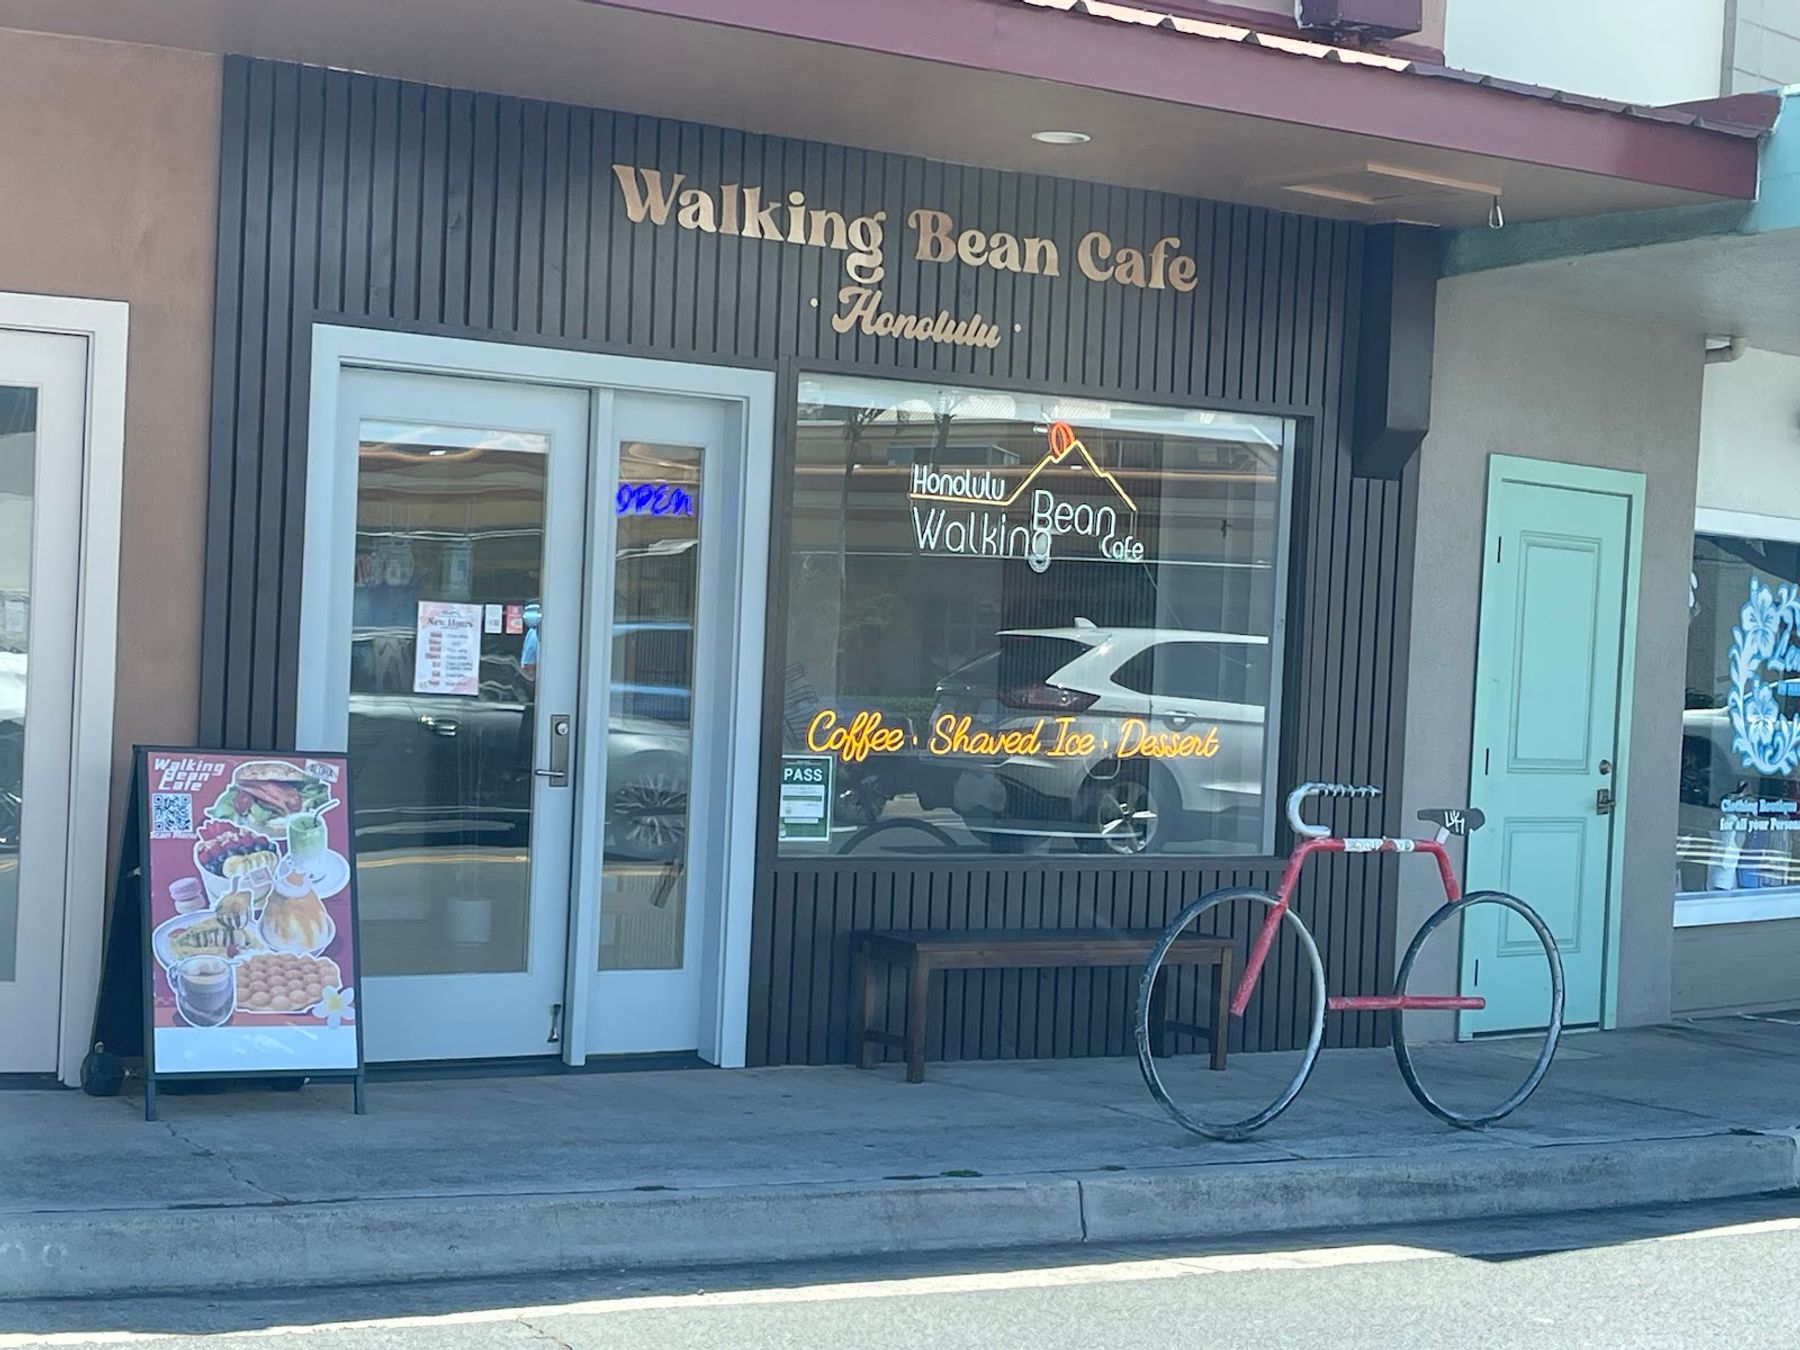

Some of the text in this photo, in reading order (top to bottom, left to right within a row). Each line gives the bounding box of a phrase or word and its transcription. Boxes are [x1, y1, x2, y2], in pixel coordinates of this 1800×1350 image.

[612, 164, 1198, 293] Walking Bean Cafe
[831, 286, 1001, 350] Honolulu
[912, 463, 1005, 500] Honolulu
[912, 489, 1117, 573] Walking Bean
[1101, 536, 1145, 560] Cafe
[807, 709, 1220, 763] Coffee Shaved Ice Dessert
[154, 758, 226, 777] Walking
[162, 768, 210, 782] Bean
[783, 767, 823, 782] PASS
